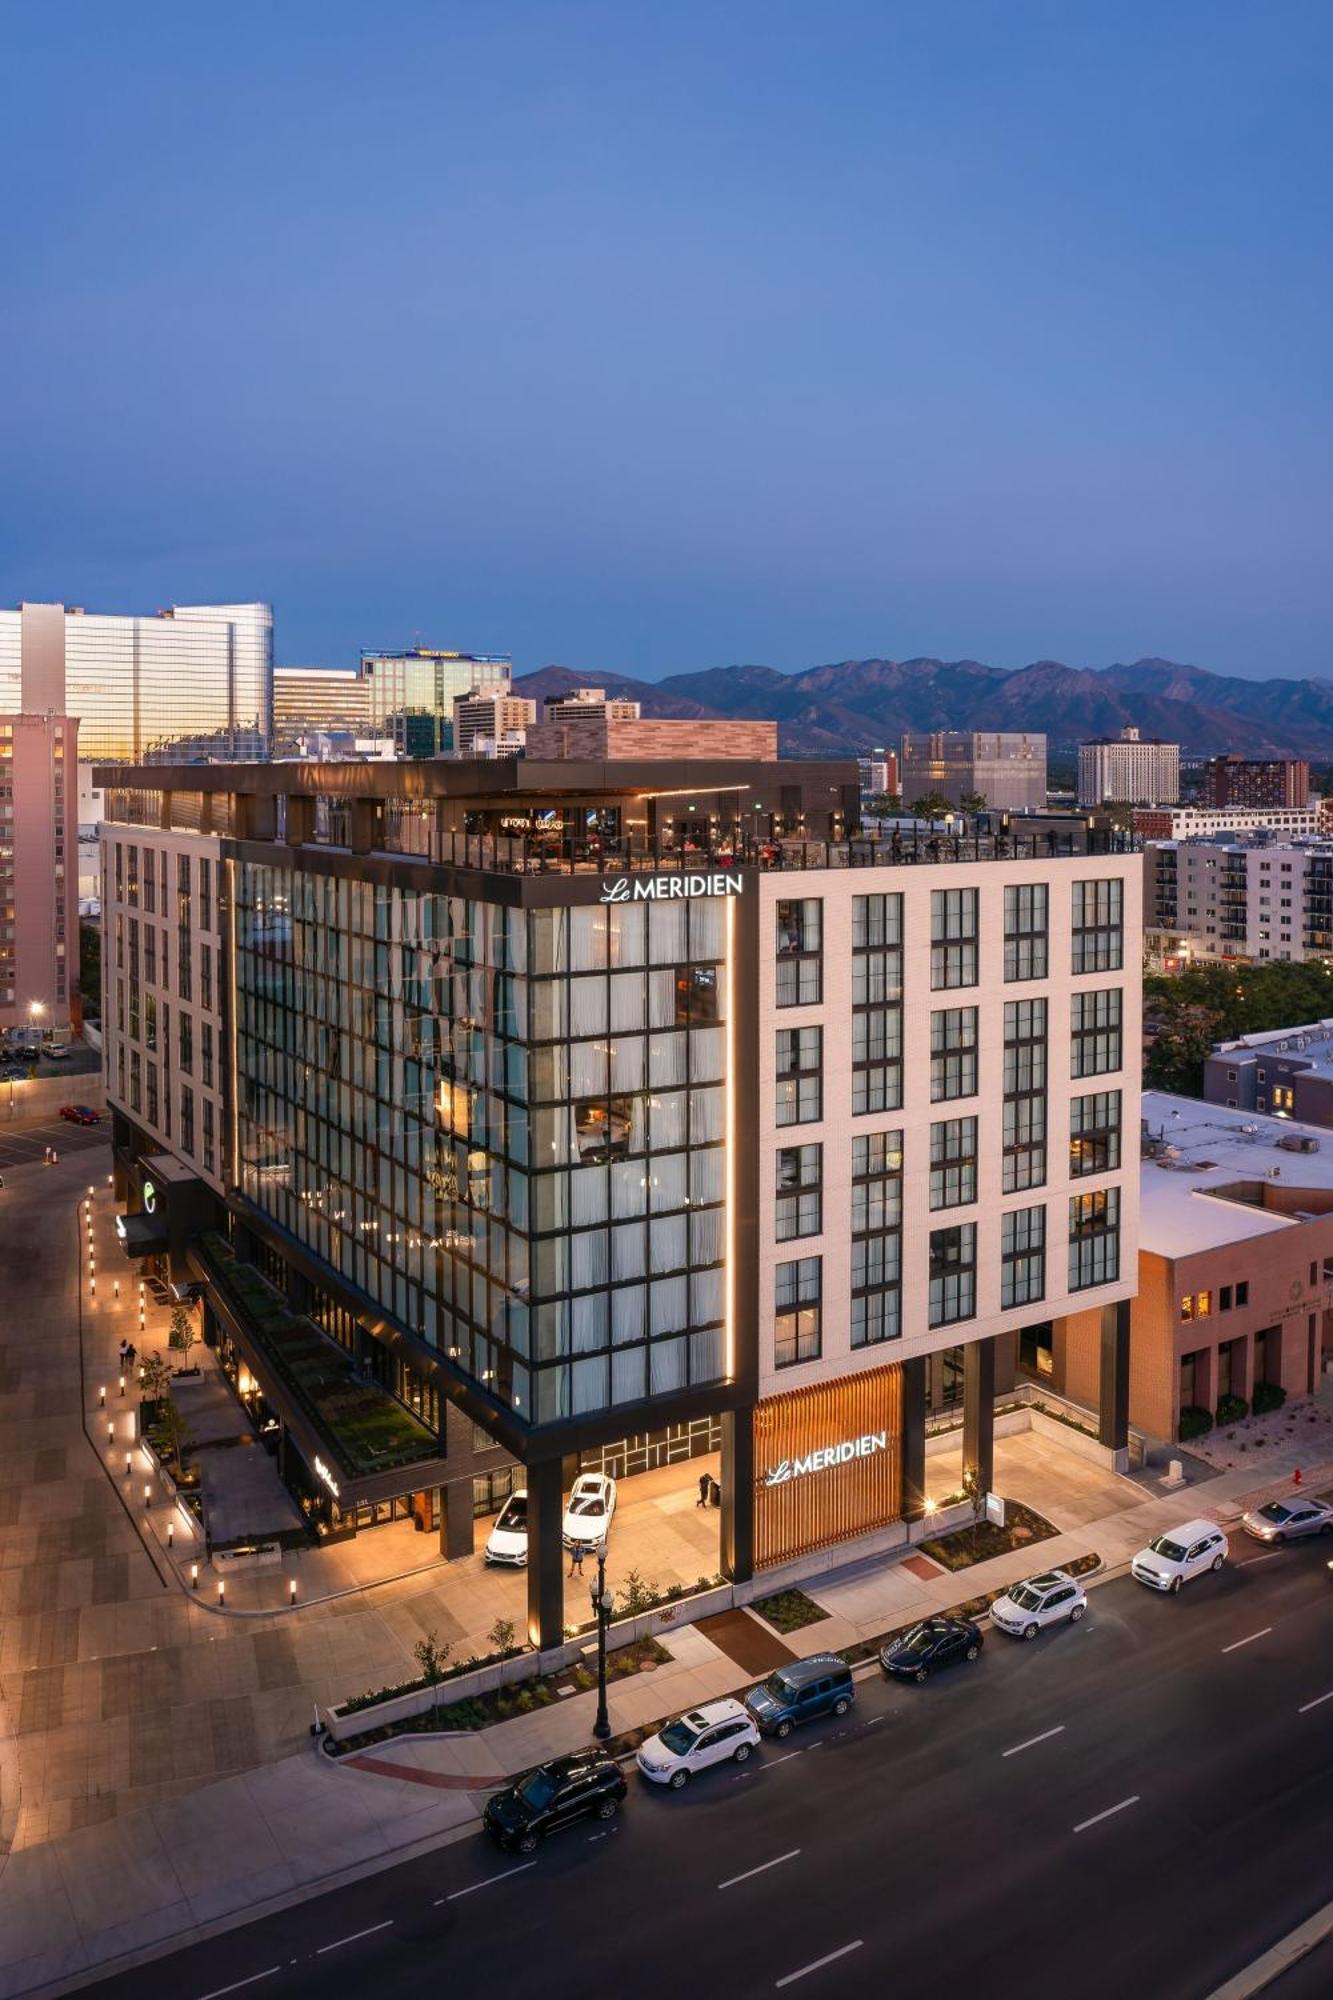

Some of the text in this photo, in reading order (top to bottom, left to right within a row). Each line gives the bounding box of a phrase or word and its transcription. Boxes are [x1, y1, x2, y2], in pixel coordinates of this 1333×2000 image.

[600, 874, 742, 902] Le MERIDIEN
[765, 1431, 886, 1486] Le MERIDIEN
